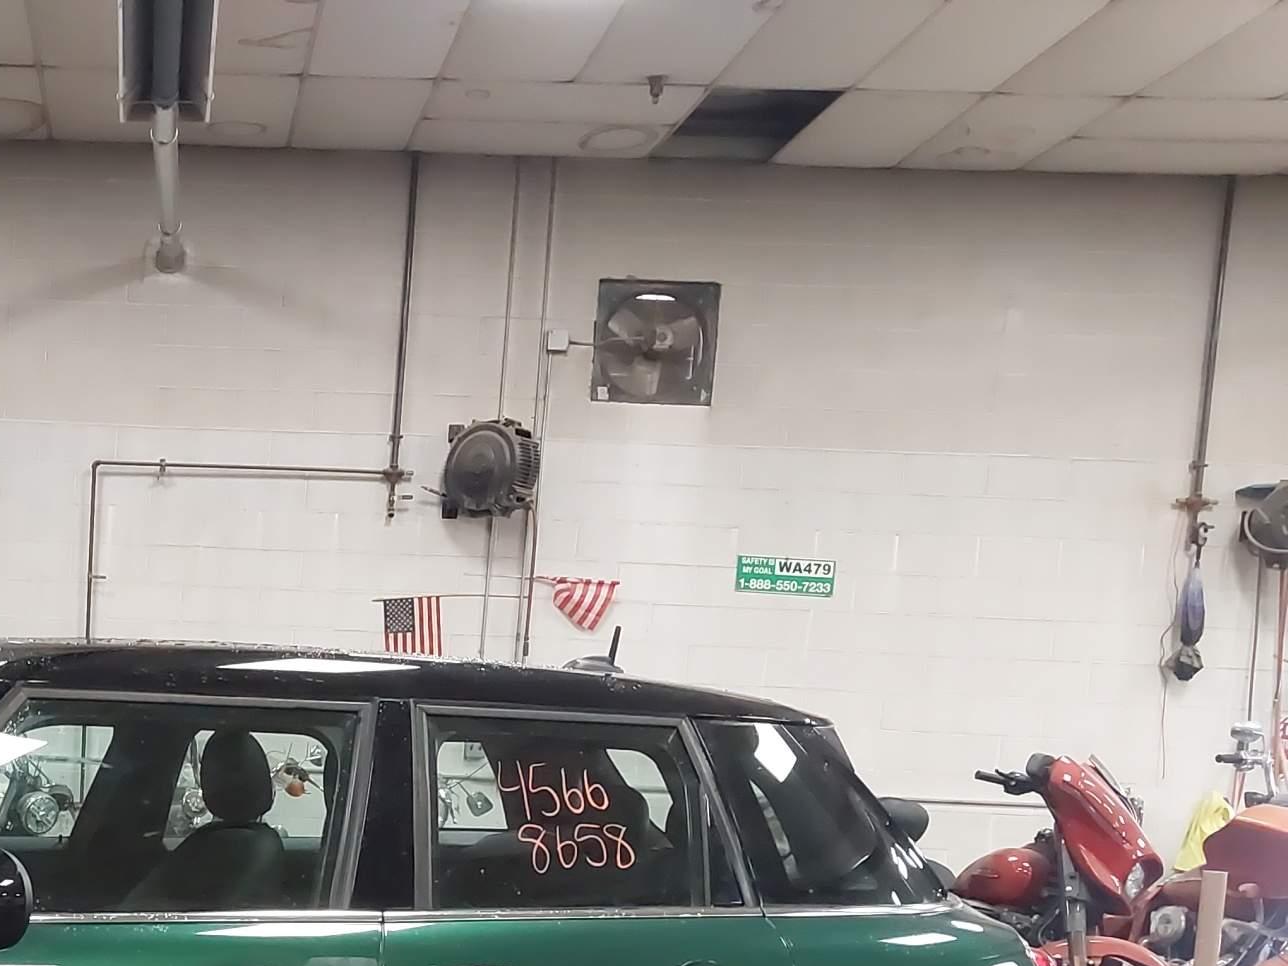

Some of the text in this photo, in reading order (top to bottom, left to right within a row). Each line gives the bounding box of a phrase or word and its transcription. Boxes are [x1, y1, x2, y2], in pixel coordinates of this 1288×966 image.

[742, 557, 768, 565] SAFETY
[779, 561, 831, 575] WA479
[743, 566, 753, 574] MY
[739, 578, 831, 593] 1-888-550-7233
[497, 760, 609, 821] 4566
[517, 823, 635, 874] 8658
